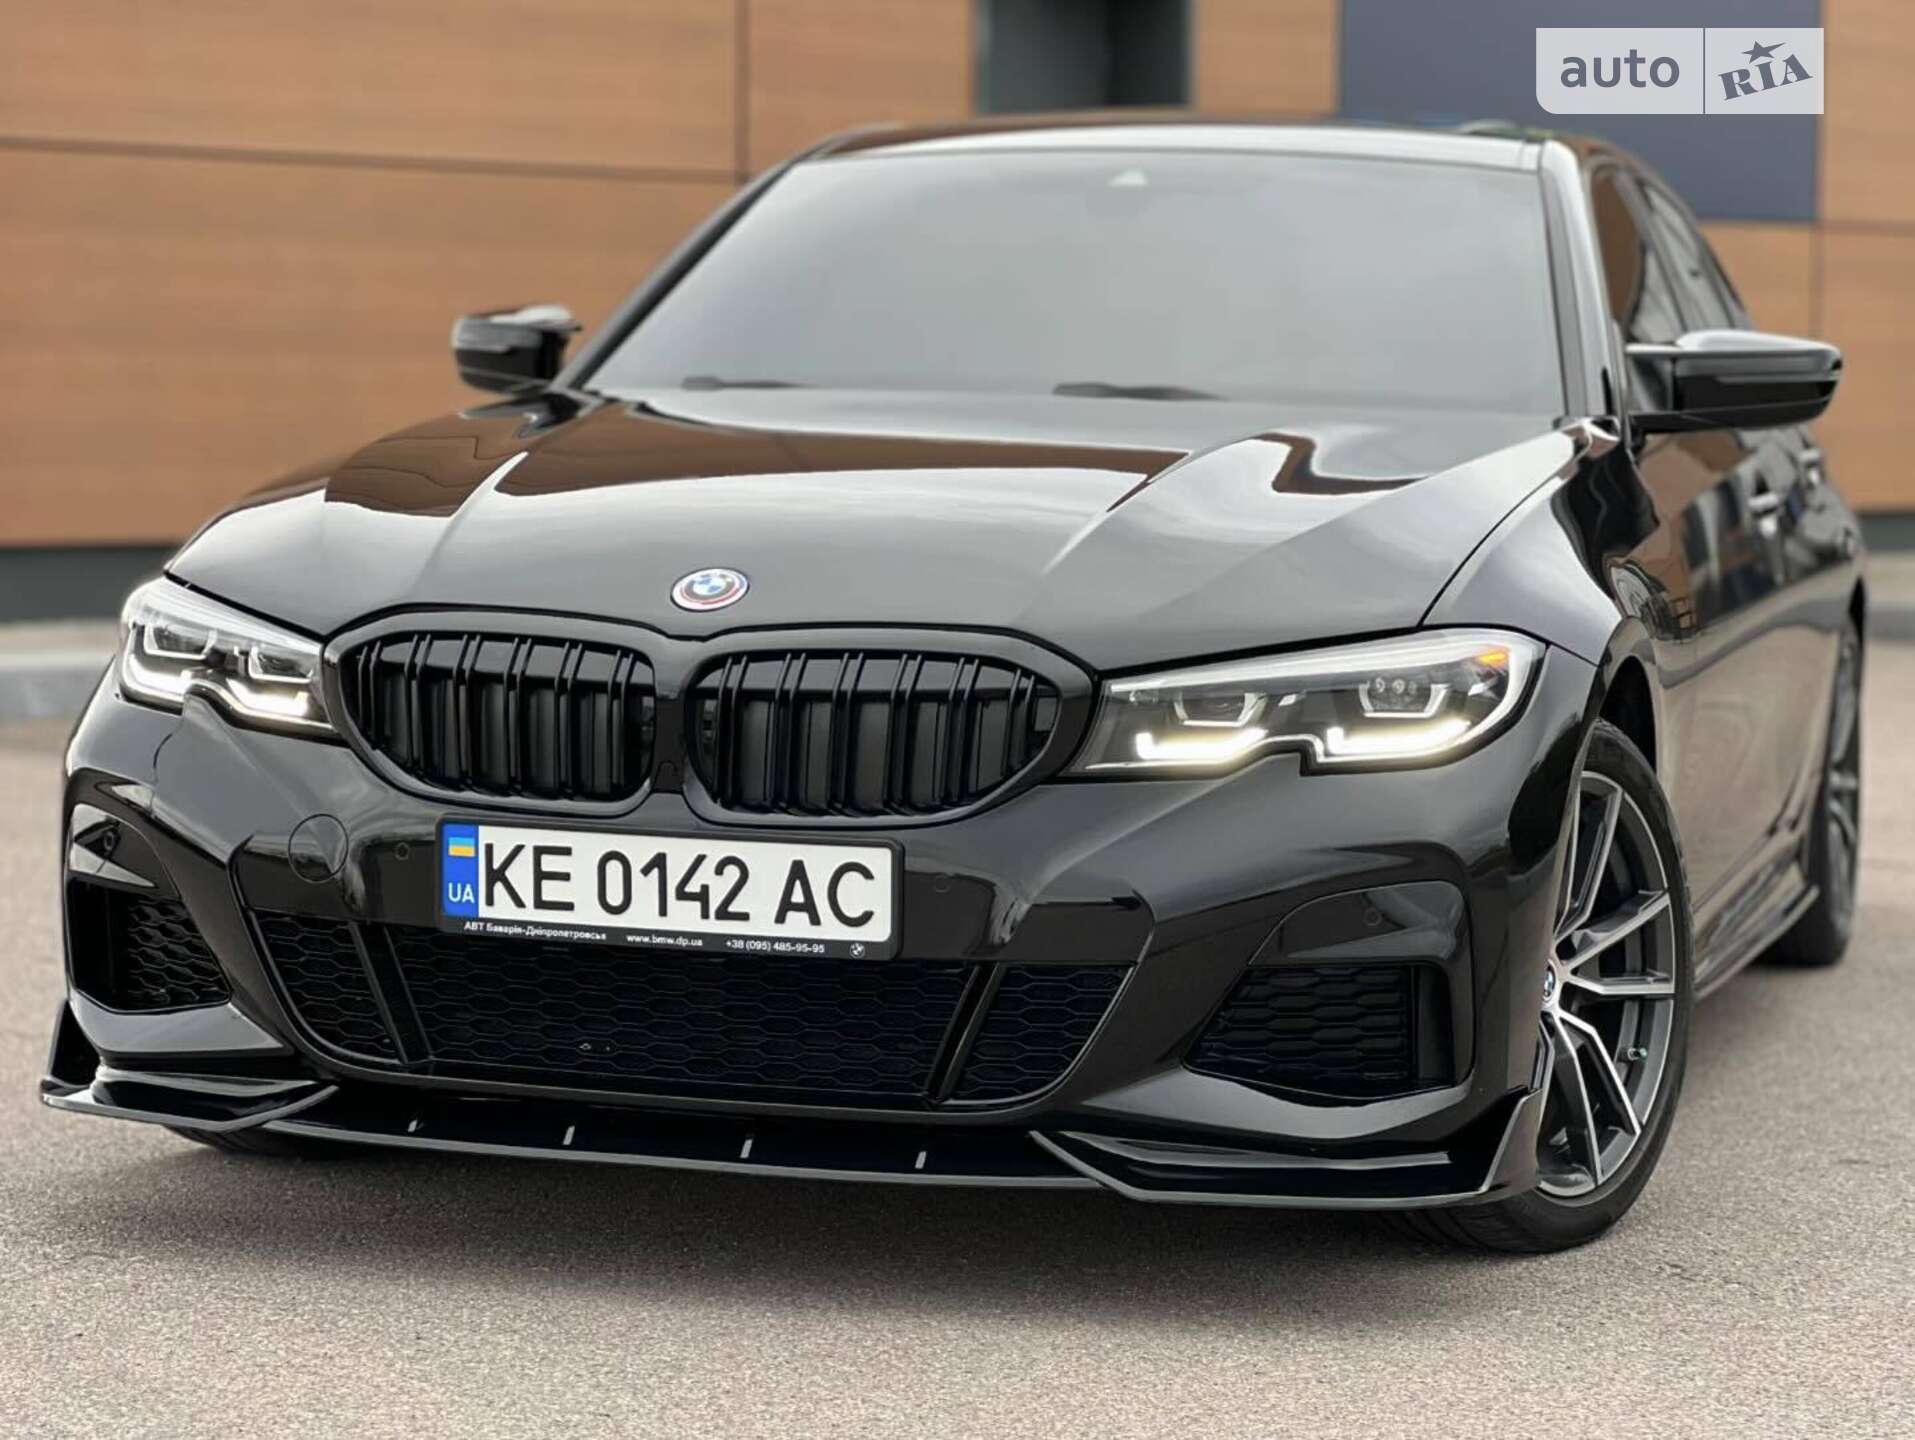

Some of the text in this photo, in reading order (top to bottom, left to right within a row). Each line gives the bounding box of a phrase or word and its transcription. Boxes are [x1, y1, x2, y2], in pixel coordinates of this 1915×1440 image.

[484, 843, 875, 928] KE 0142 AC
[448, 884, 475, 904] UA
[626, 934, 703, 947] www.bmw.dp.ua
[725, 940, 744, 949] +38
[745, 940, 771, 952] (095)
